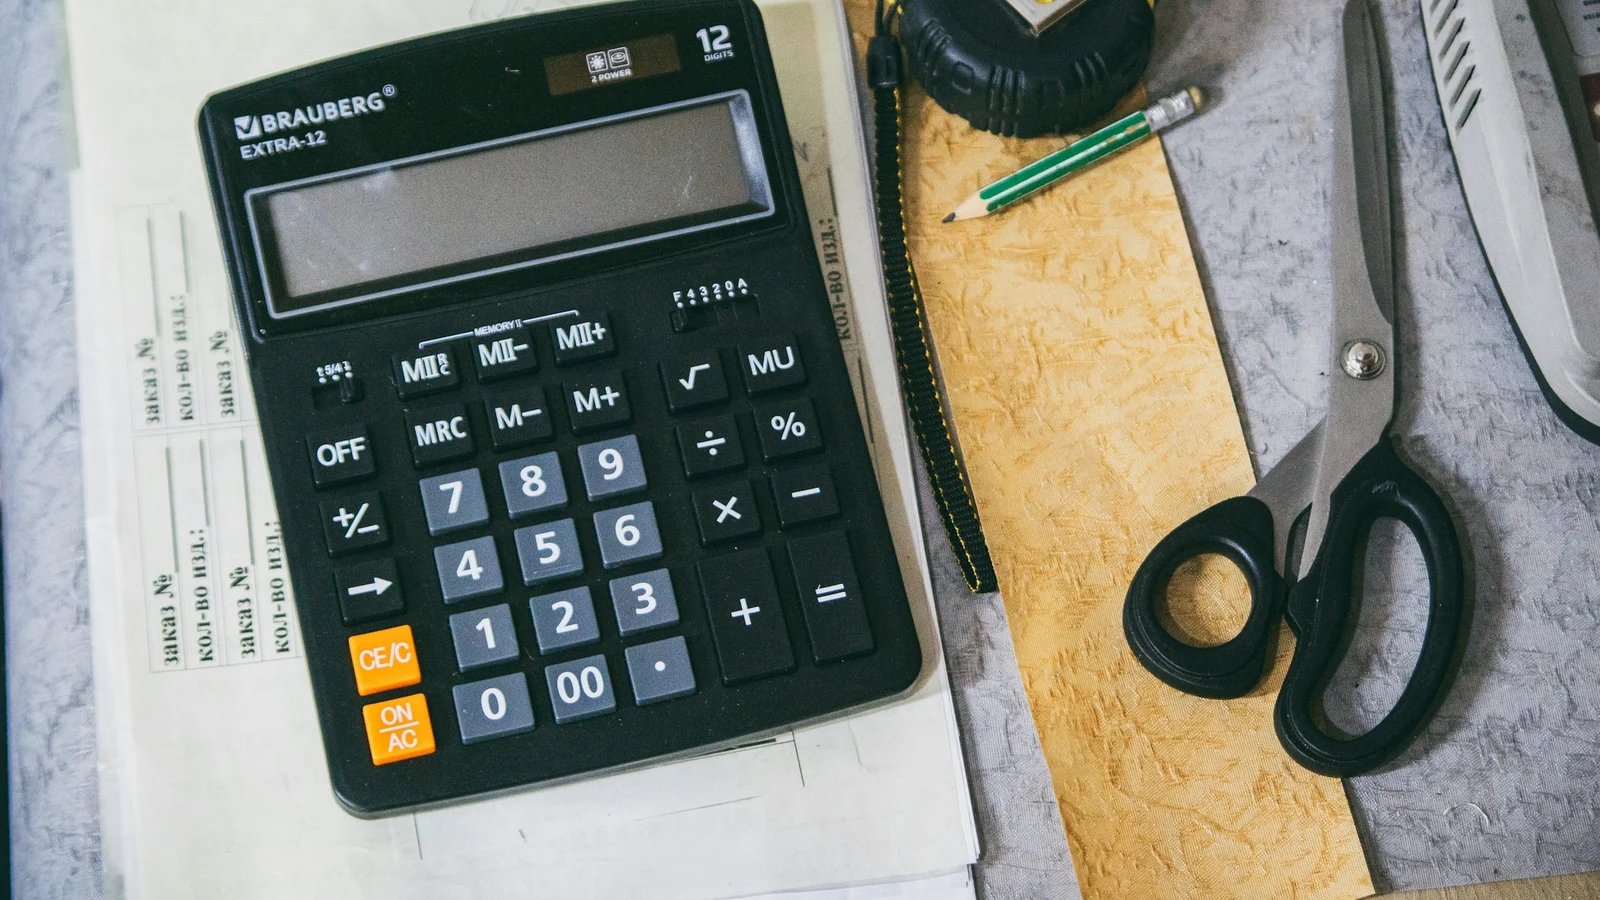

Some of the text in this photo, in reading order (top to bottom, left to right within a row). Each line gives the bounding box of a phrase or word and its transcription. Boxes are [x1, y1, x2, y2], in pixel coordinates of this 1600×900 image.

[696, 25, 732, 51] 12
[703, 49, 734, 62] DIGITS
[591, 68, 632, 83] 2 POWER
[239, 130, 327, 159] EXTRA-12
[673, 278, 747, 301] F 4 3 2 0 A
[474, 321, 514, 336] MEMORY
[748, 347, 794, 375] MU
[574, 387, 619, 412] M+
[415, 417, 466, 446] MRC
[317, 437, 365, 466] OFF
[598, 448, 624, 480] 9
[520, 465, 547, 497] 8
[439, 481, 465, 514] 7
[615, 514, 640, 546] 6
[535, 531, 561, 564] 5
[456, 549, 485, 580] 4
[631, 582, 657, 615] 3
[237, 597, 256, 659] заказ
[553, 600, 579, 634] 2
[160, 605, 178, 667] заказ
[476, 618, 498, 649] 1
[359, 640, 411, 671] CE/C
[554, 666, 604, 705] 00
[380, 703, 413, 726] ON
[481, 688, 506, 720] 0
[387, 729, 419, 753] AC
